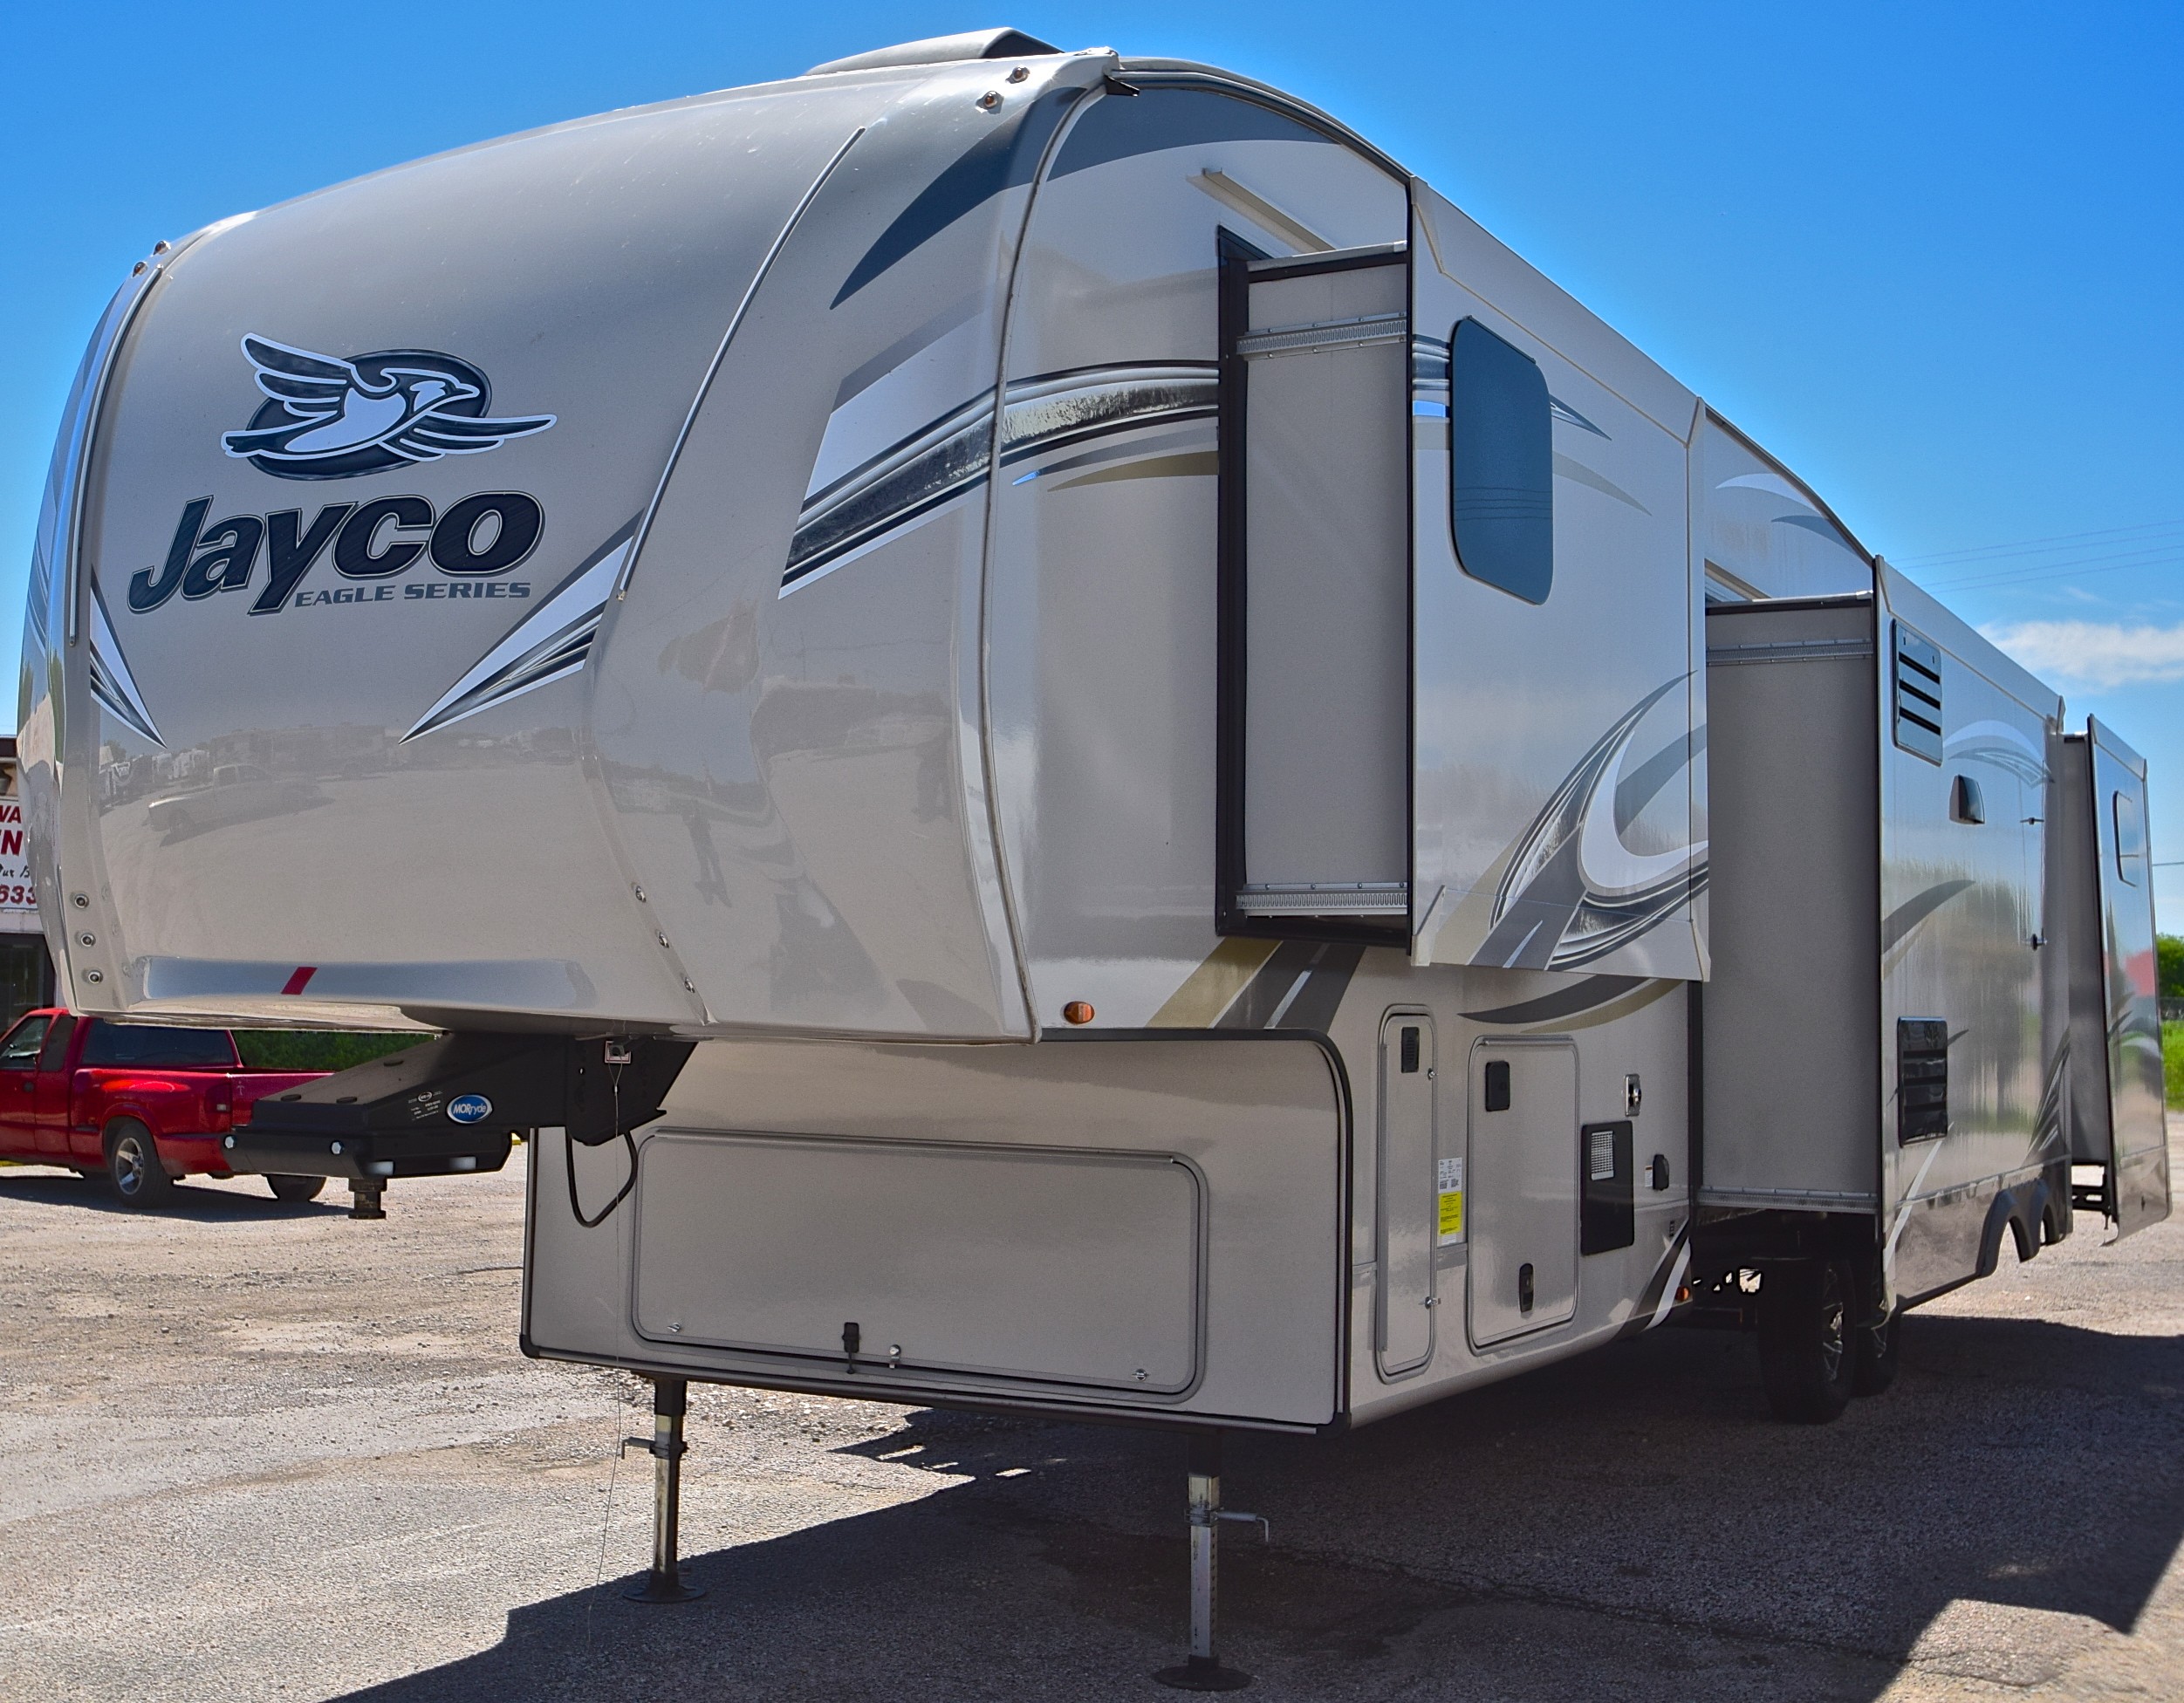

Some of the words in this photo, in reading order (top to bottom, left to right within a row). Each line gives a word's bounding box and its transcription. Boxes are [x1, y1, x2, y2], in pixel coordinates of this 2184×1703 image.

[127, 490, 545, 616] Jayco
[295, 586, 395, 608] EAGLE
[404, 582, 531, 601] SERIES
